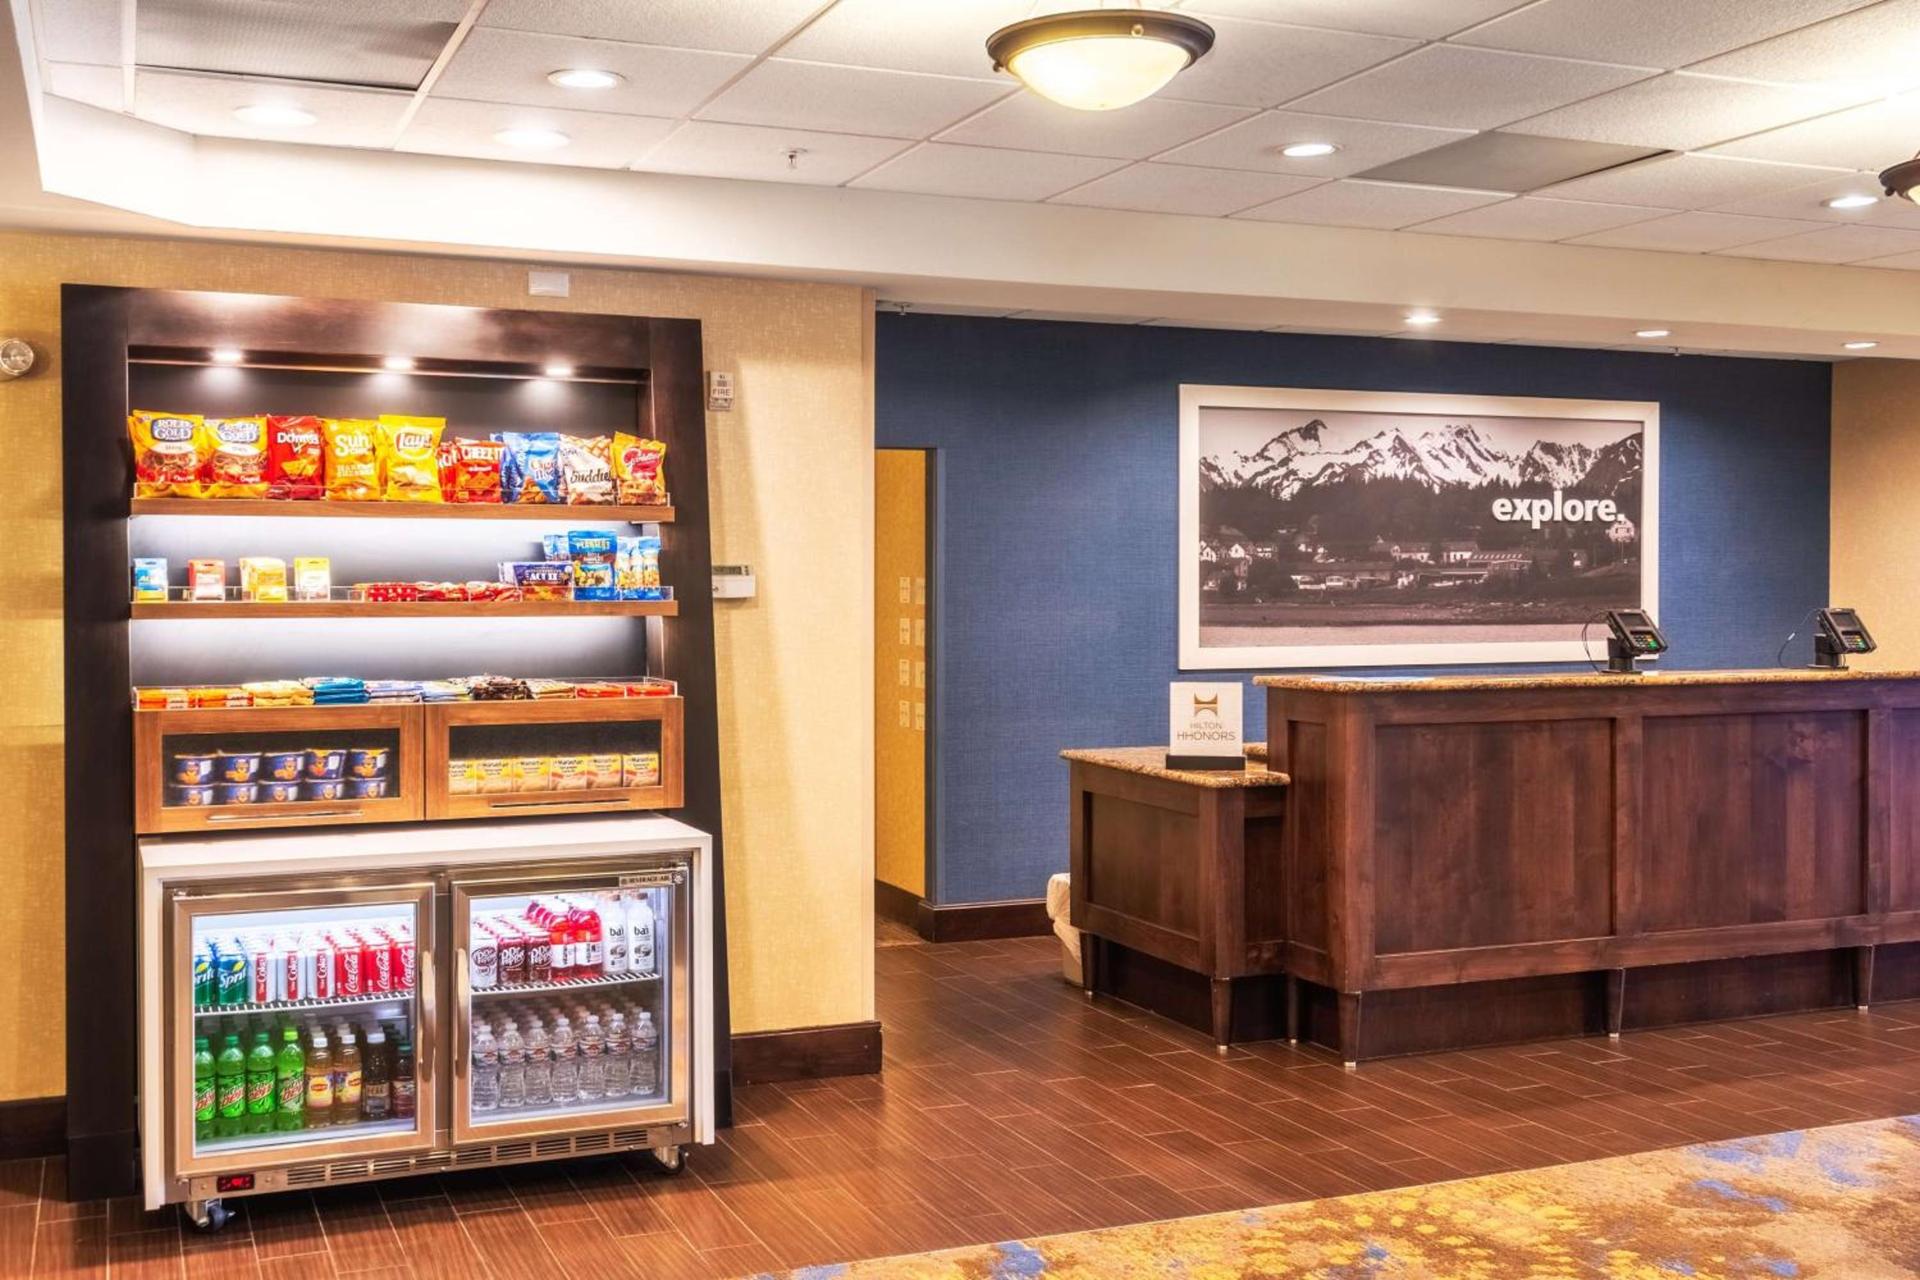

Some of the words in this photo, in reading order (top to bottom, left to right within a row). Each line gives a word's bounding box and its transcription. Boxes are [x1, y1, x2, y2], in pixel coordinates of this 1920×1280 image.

[712, 388, 731, 396] FIRE
[1492, 490, 1625, 529] explore.
[1177, 731, 1236, 741] HHONORS
[610, 925, 624, 937] bai
[634, 925, 649, 936] bai
